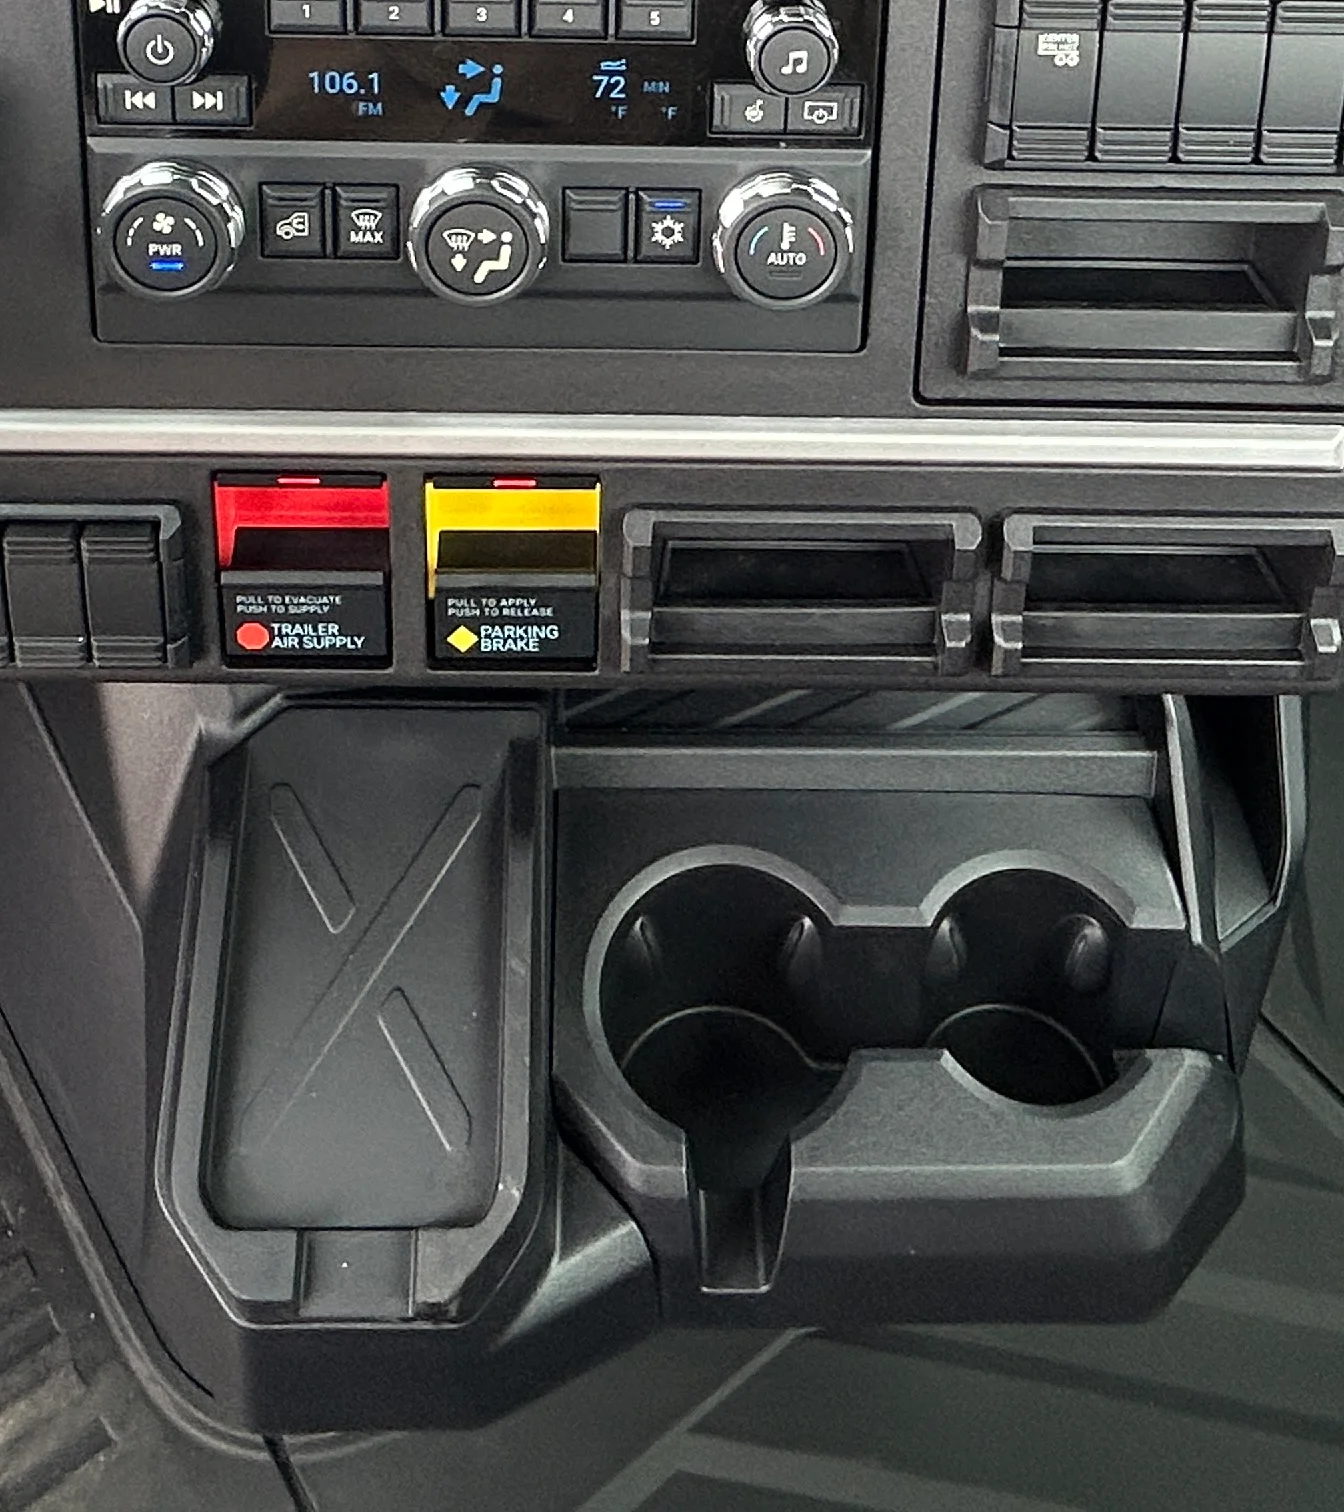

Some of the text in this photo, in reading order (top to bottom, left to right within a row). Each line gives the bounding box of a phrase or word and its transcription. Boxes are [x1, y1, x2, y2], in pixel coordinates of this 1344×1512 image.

[302, 4, 311, 18] 1
[388, 6, 400, 20] 2
[476, 7, 488, 22] 3
[562, 8, 574, 23] 4
[649, 10, 661, 26] 5
[308, 71, 380, 94] 106.1
[592, 74, 626, 98] 72
[358, 101, 383, 116] FM
[350, 230, 384, 244] MAX
[148, 243, 182, 256] PWR
[767, 252, 807, 265] AUTO
[236, 595, 343, 605] PULL TO EVACUATE
[447, 598, 537, 607] PULL TO APPLY
[236, 605, 330, 614] PUSH TO SUPPLY
[447, 607, 554, 617] PUSH TO RELEASE
[271, 623, 340, 636] TRAILER
[480, 625, 559, 639] PARKING
[271, 636, 366, 649] AIR SUPPLY
[480, 638, 540, 652] BRAKE
